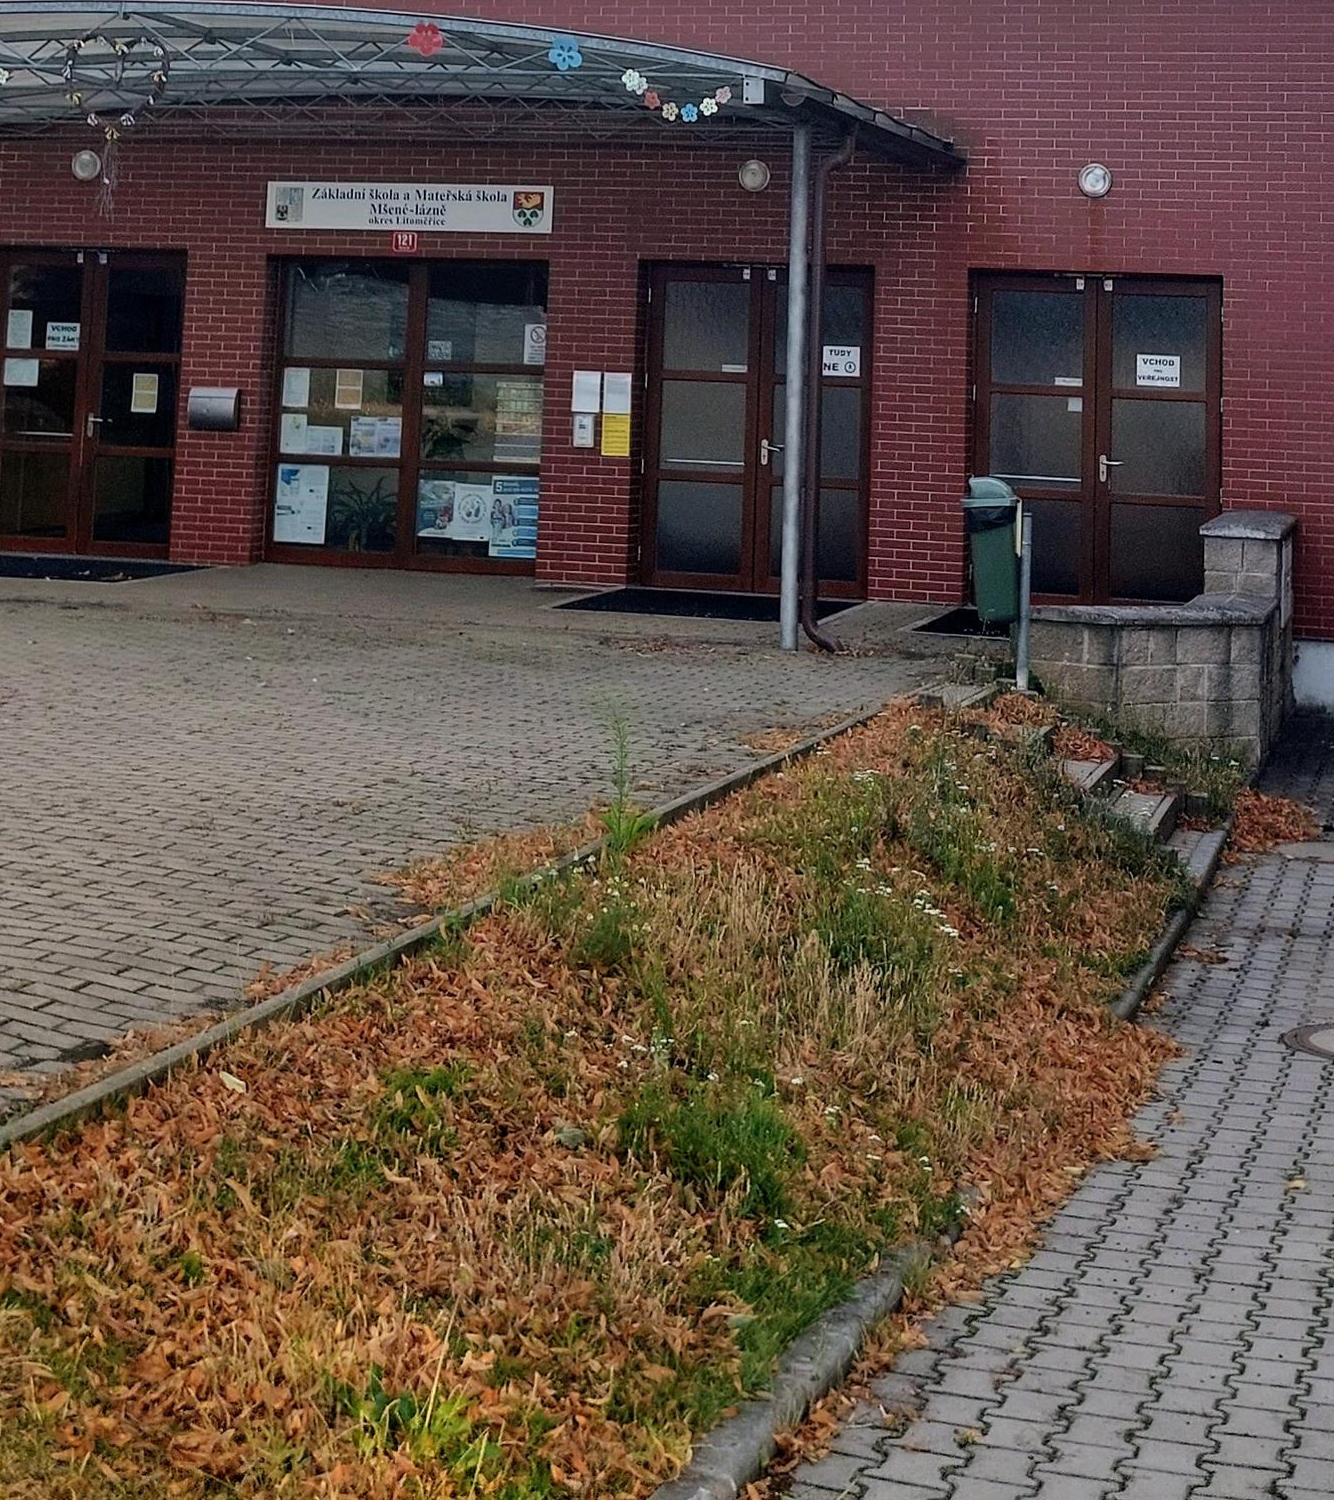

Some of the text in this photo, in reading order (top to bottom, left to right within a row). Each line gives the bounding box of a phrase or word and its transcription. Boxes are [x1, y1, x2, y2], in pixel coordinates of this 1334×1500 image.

[312, 187, 508, 202] Základní škola a Mateřská škola
[369, 203, 446, 216] Mšené-lázně
[368, 216, 446, 226] okres Litoměřice
[397, 234, 412, 246] 121
[823, 363, 839, 371] NE
[1142, 358, 1174, 366] VCHOD
